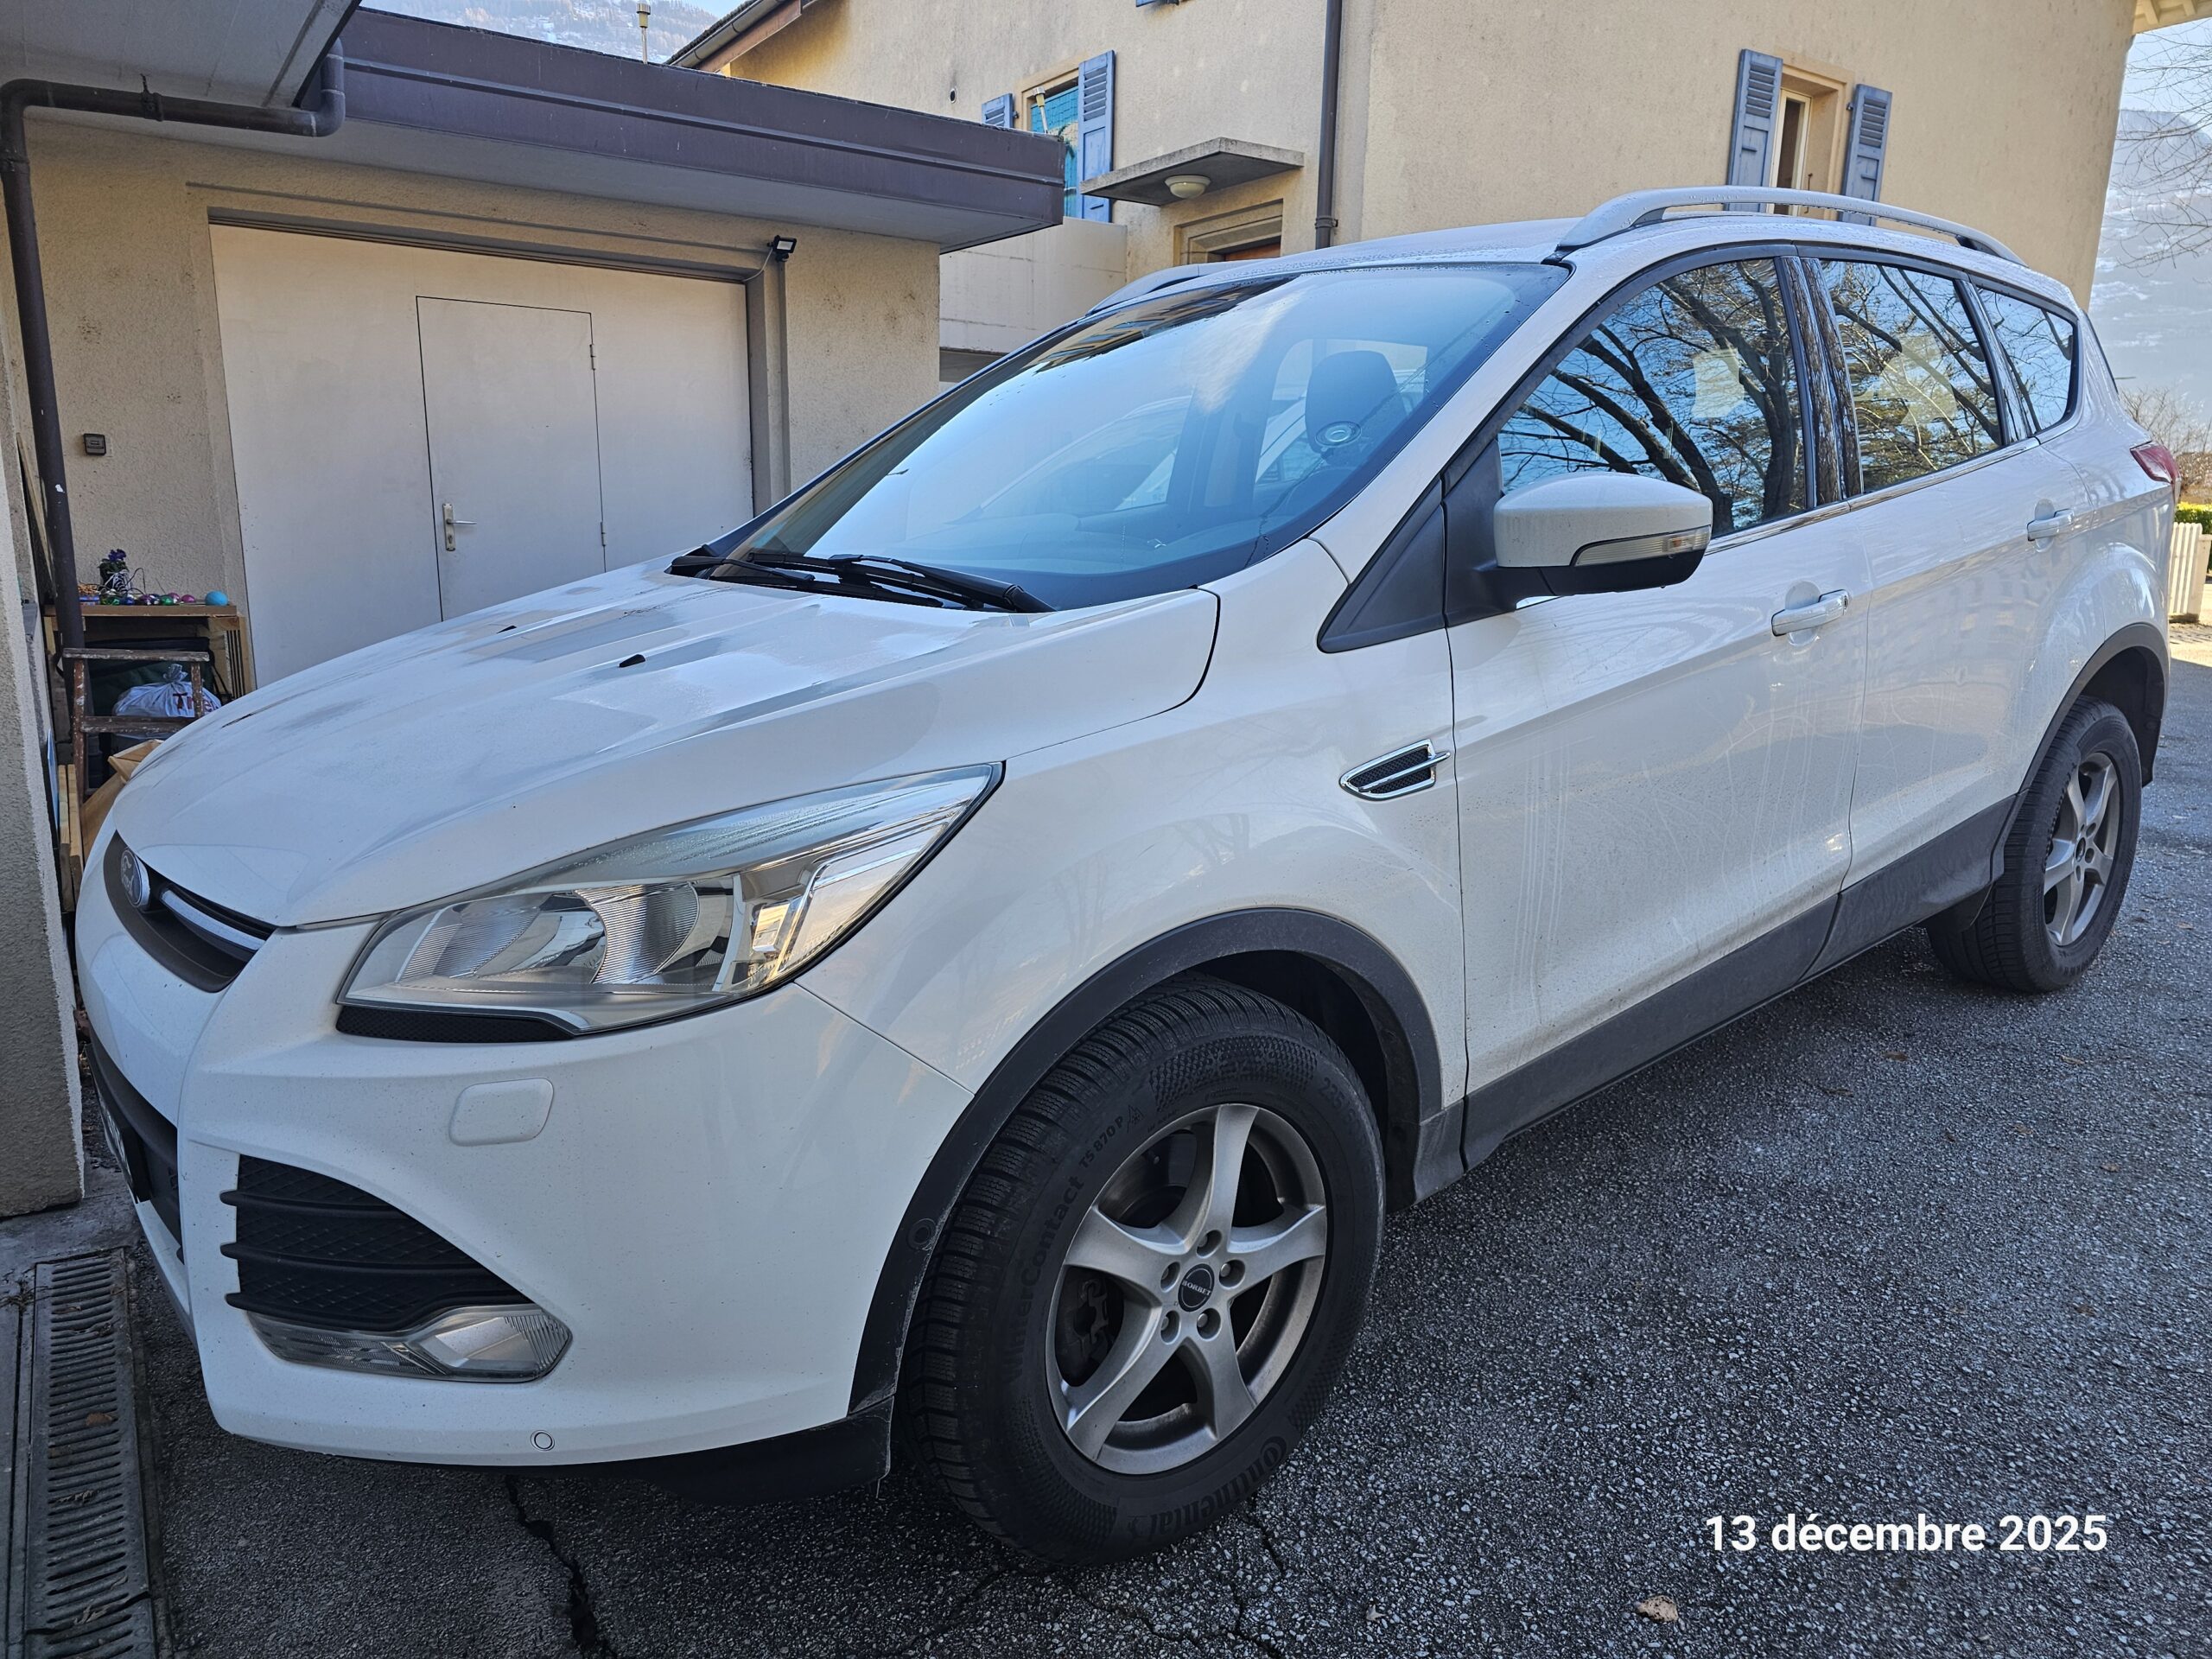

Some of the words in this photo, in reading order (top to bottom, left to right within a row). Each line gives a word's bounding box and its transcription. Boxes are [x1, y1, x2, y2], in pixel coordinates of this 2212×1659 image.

[1078, 1149, 1095, 1168] TS
[1093, 1125, 1116, 1152] 870
[1115, 1116, 1123, 1128] P
[1181, 1280, 1211, 1296] BORBET
[1148, 1435, 1287, 1542] Continental
